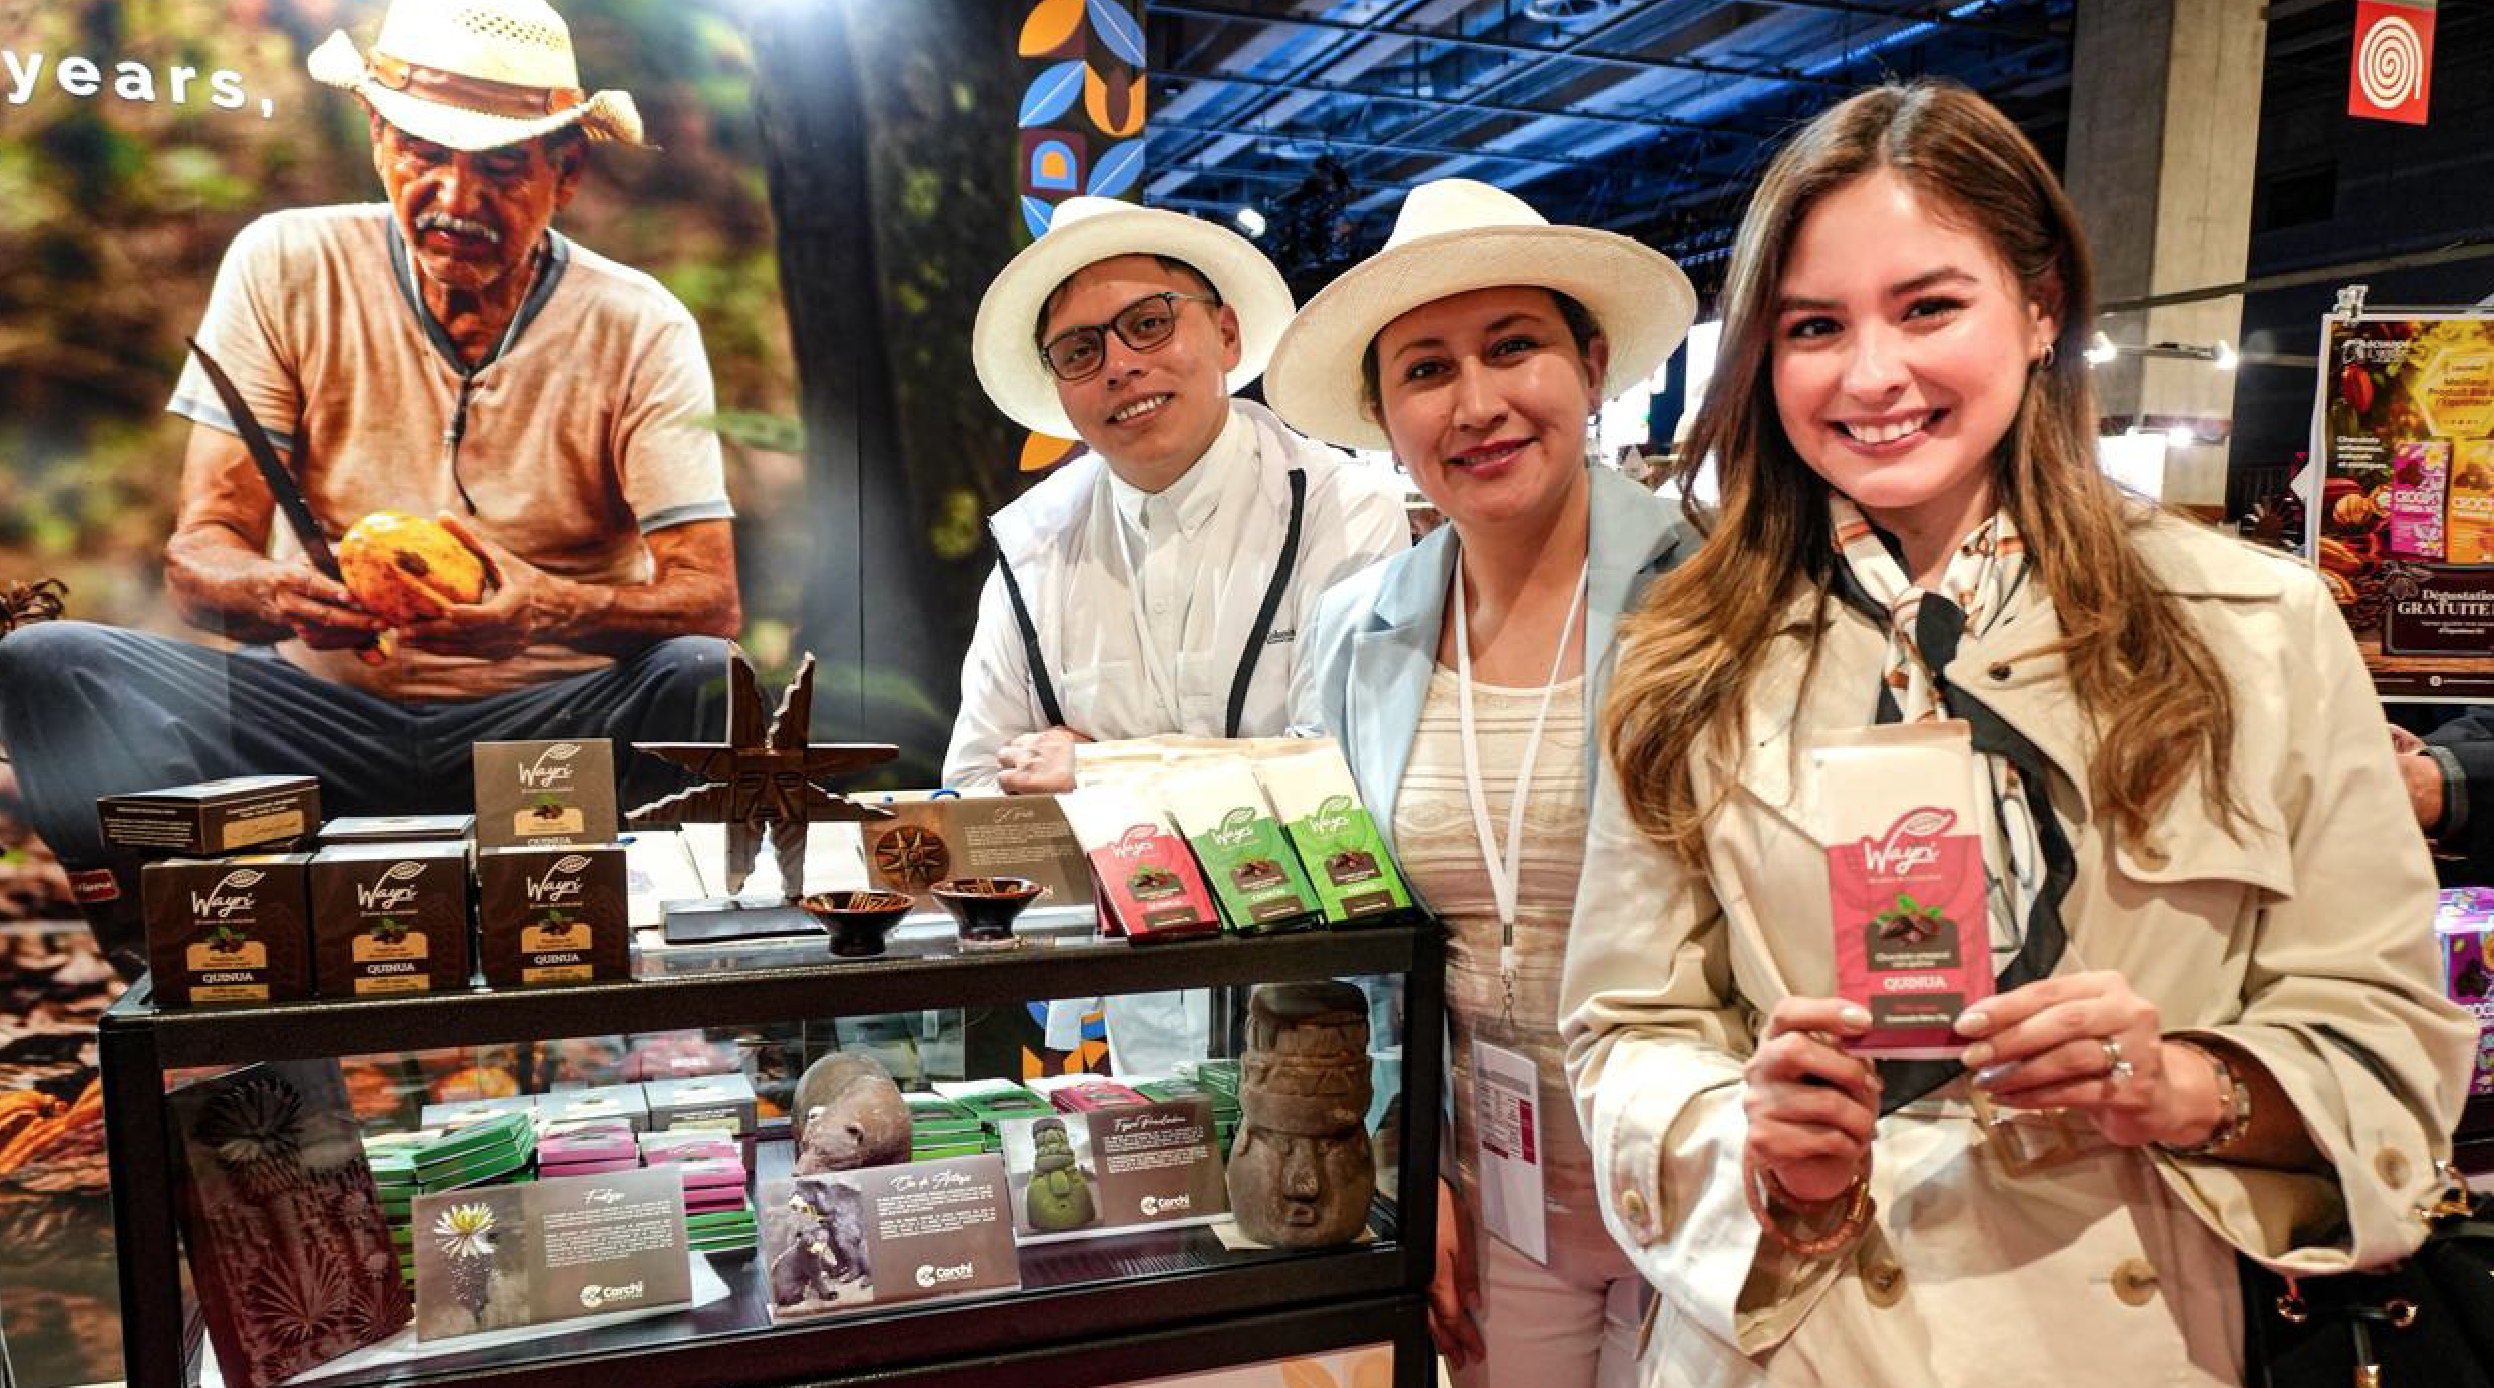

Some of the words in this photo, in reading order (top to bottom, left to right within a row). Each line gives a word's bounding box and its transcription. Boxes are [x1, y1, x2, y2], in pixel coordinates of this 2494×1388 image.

[1, 50, 274, 118] years,
[1863, 828, 1942, 876] Wayri
[190, 881, 257, 918] Wayri
[357, 873, 419, 909] Wayri
[526, 867, 585, 901] Wayri
[366, 962, 415, 975] QUINUA
[534, 953, 580, 965] QUINUA
[202, 972, 254, 984] QUINUA
[1883, 975, 1946, 991] QUINUA
